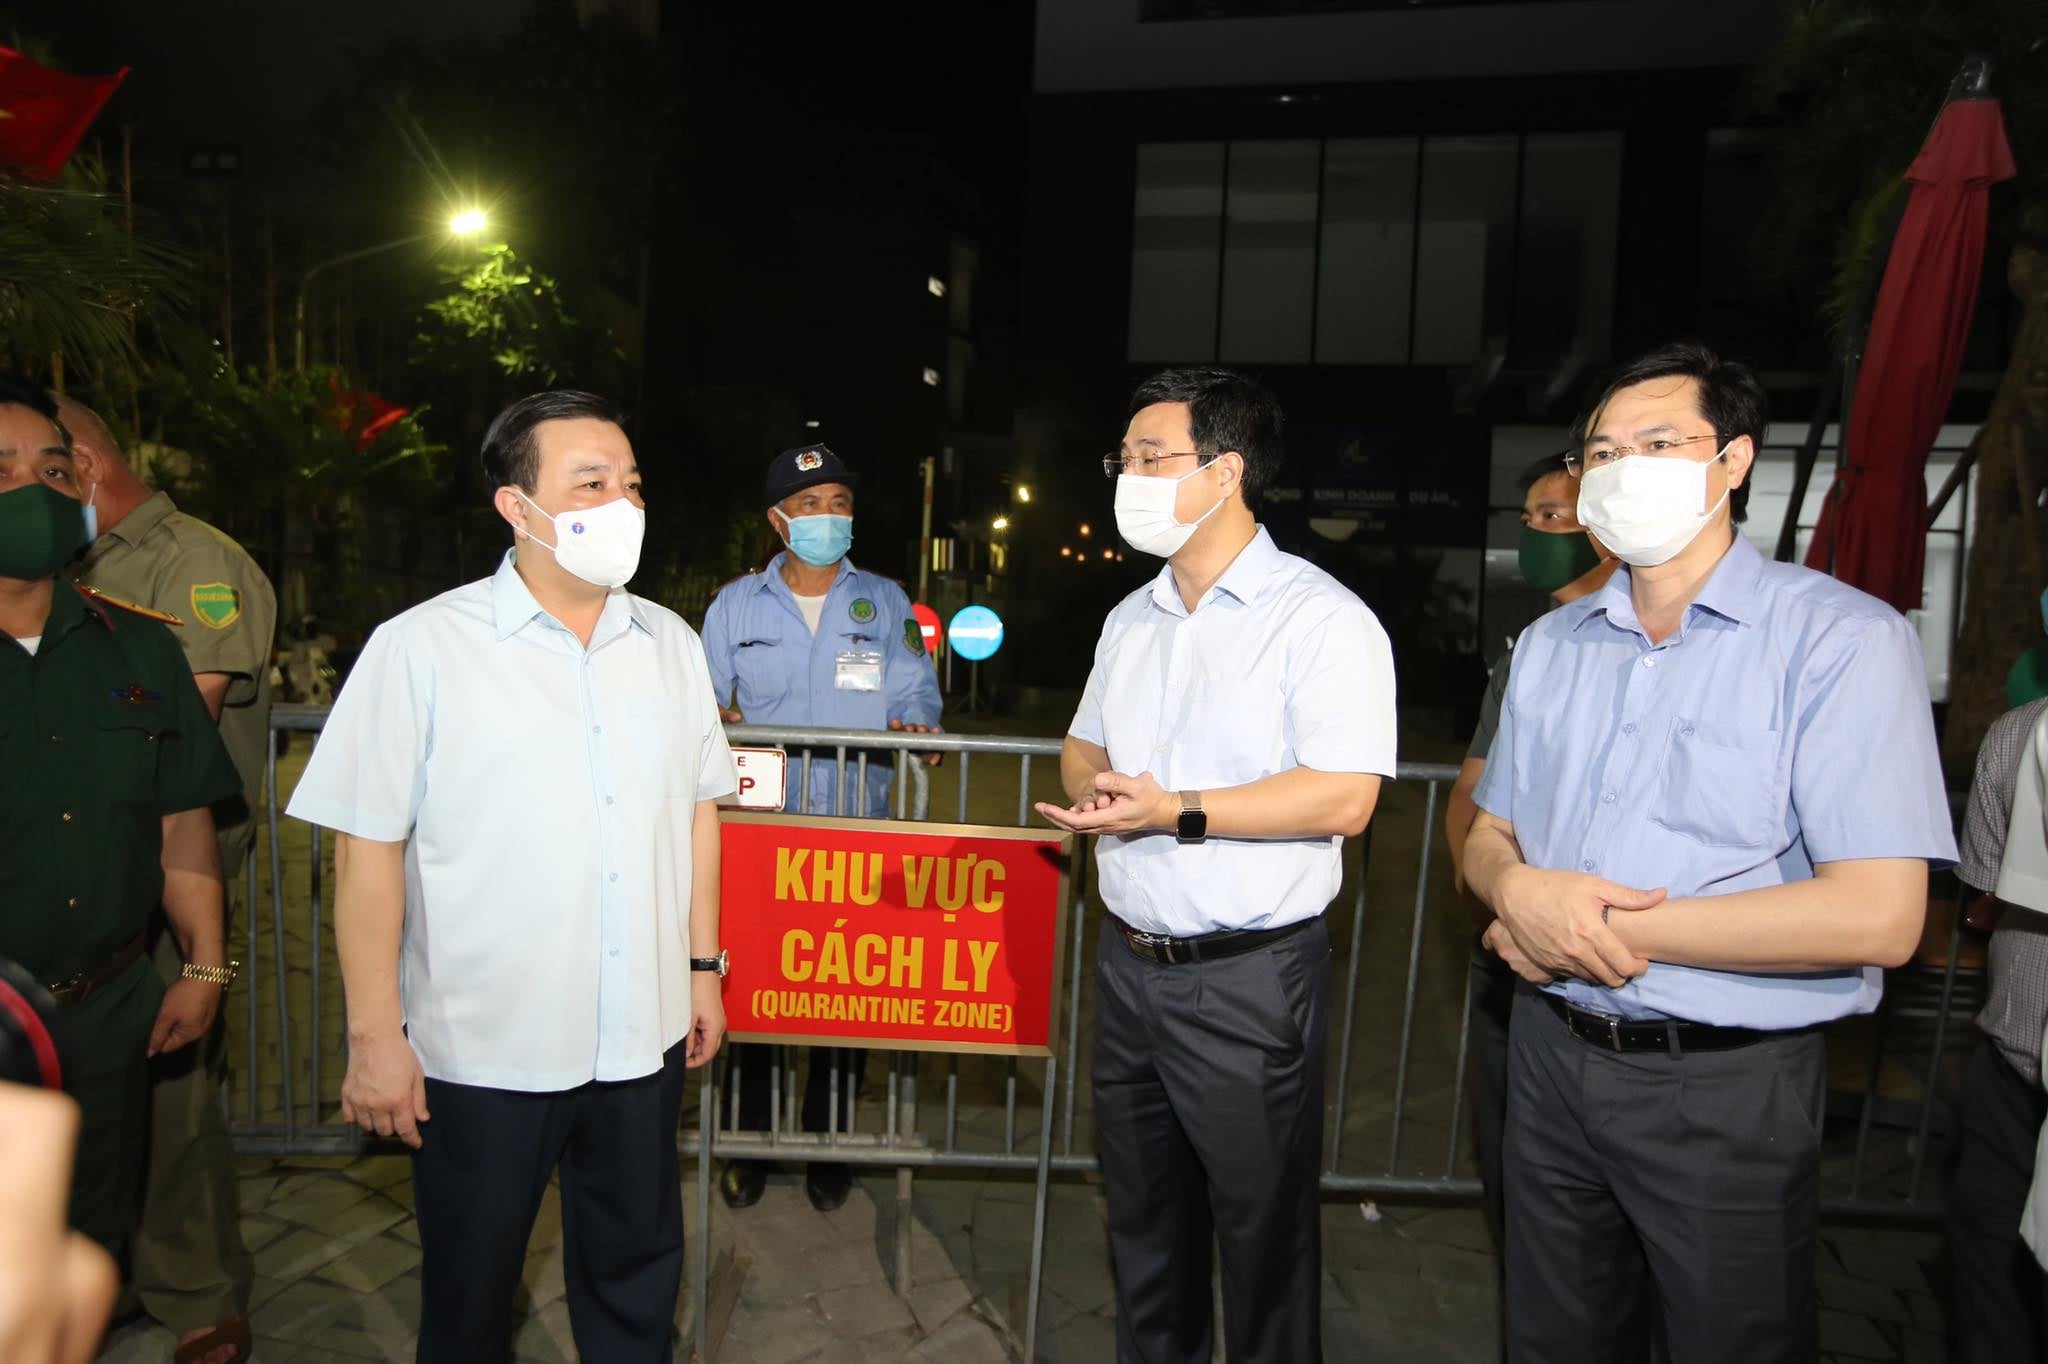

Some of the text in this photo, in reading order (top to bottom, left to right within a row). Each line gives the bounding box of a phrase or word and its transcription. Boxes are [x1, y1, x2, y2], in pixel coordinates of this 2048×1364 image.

[737, 756, 746, 767] E
[738, 776, 756, 796] P
[774, 847, 1006, 922] KHU VỰC
[780, 918, 1000, 993] CÁCH LY
[751, 989, 1013, 1032] (QUARANTINE ZONE)
